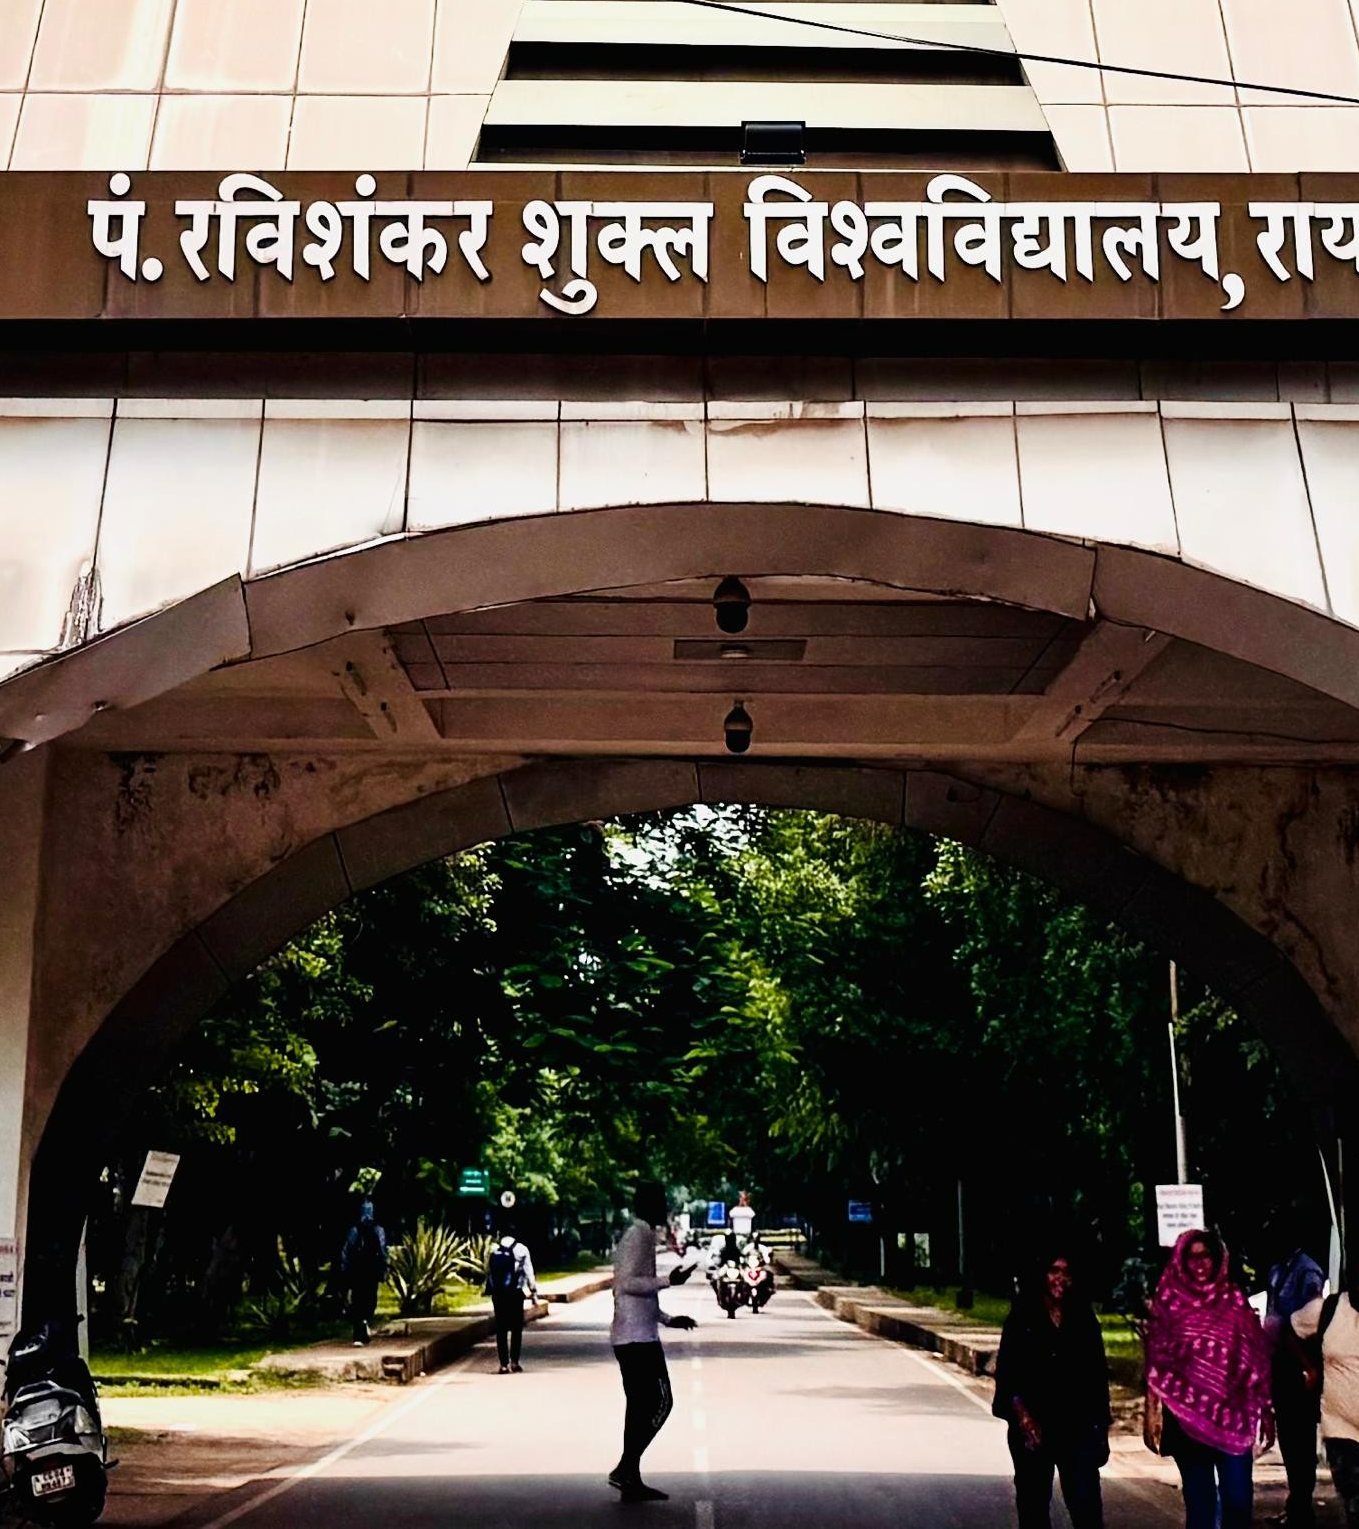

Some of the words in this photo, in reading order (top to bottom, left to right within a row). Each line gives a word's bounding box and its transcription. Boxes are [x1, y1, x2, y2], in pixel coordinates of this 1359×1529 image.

[87, 172, 165, 282] पं.
[174, 172, 493, 282] रविशंकर
[520, 199, 714, 316] शुक्ल
[743, 173, 1245, 311] विश्वविद्यालय,
